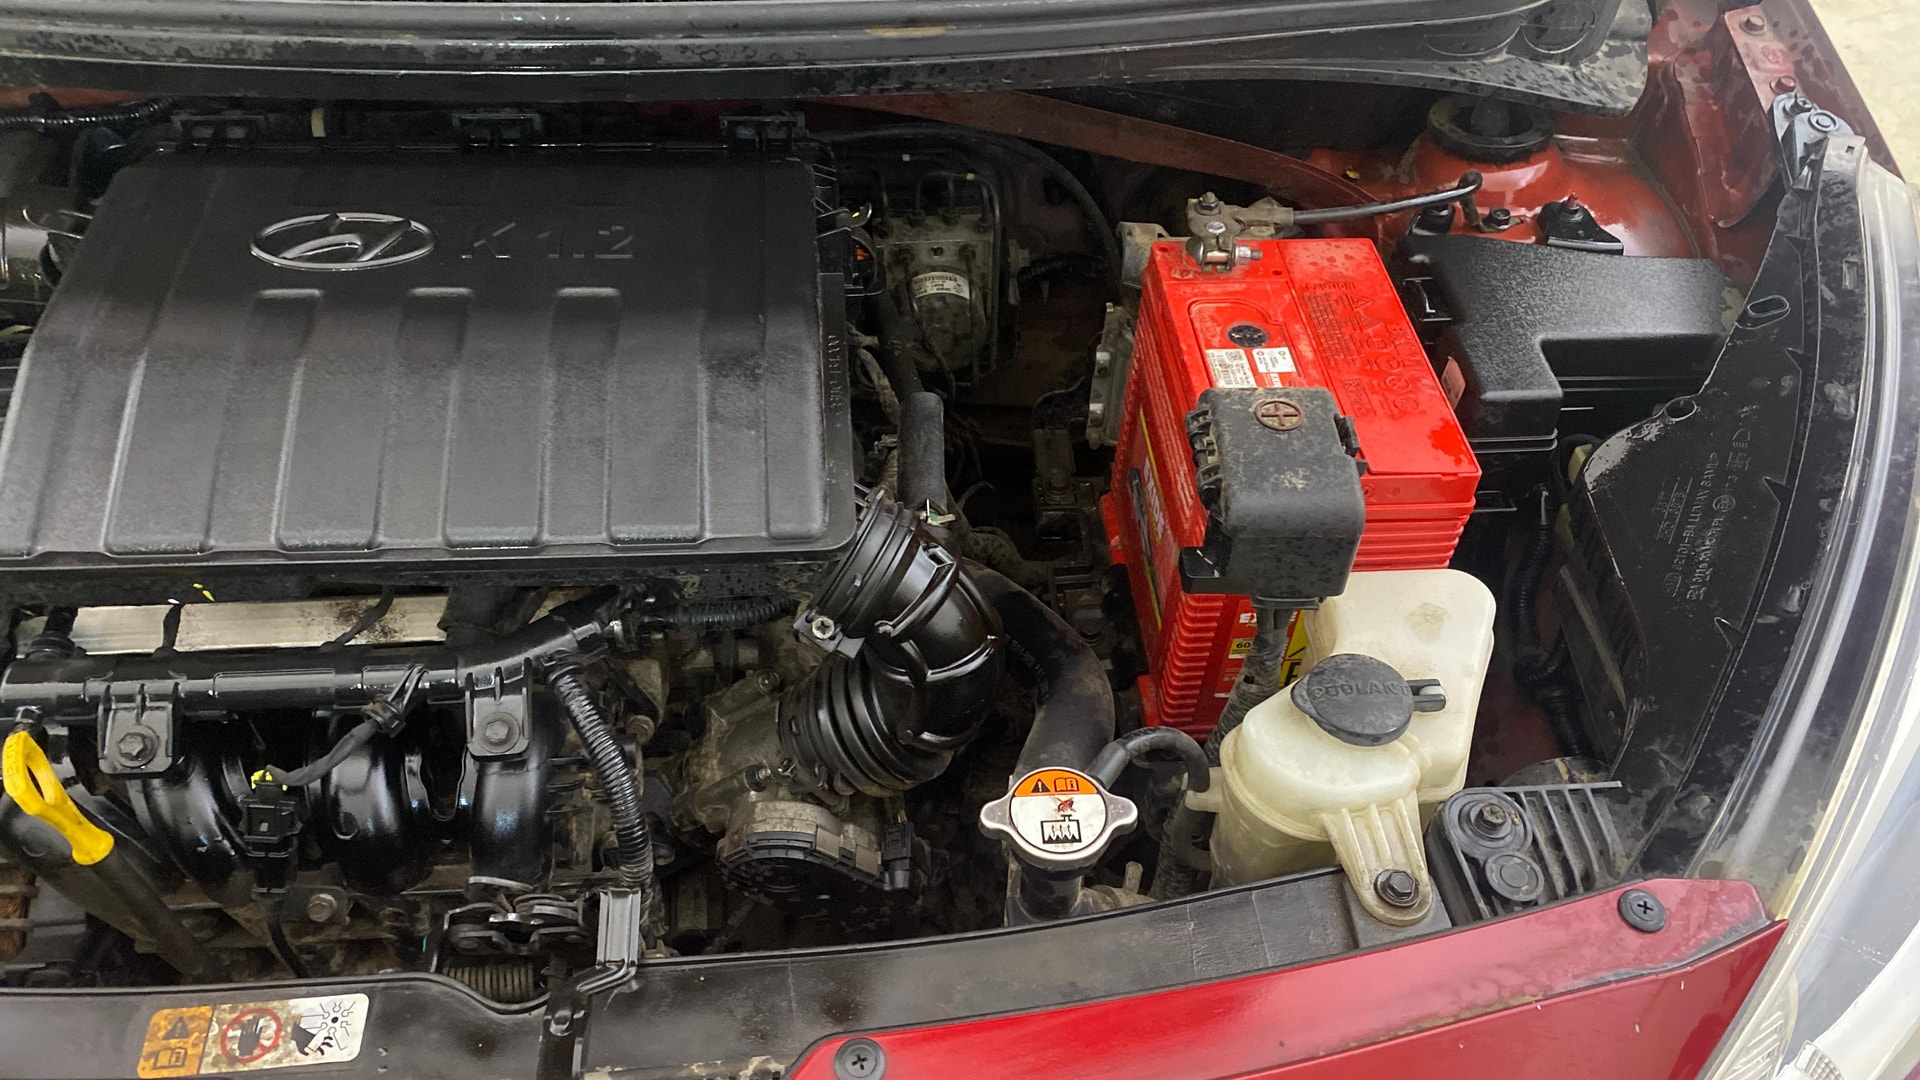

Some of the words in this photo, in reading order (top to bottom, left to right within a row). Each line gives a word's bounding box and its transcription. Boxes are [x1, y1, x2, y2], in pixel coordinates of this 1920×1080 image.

[460, 222, 512, 259] K
[537, 224, 633, 259] 1.2
[1310, 680, 1409, 699] COOLANT
